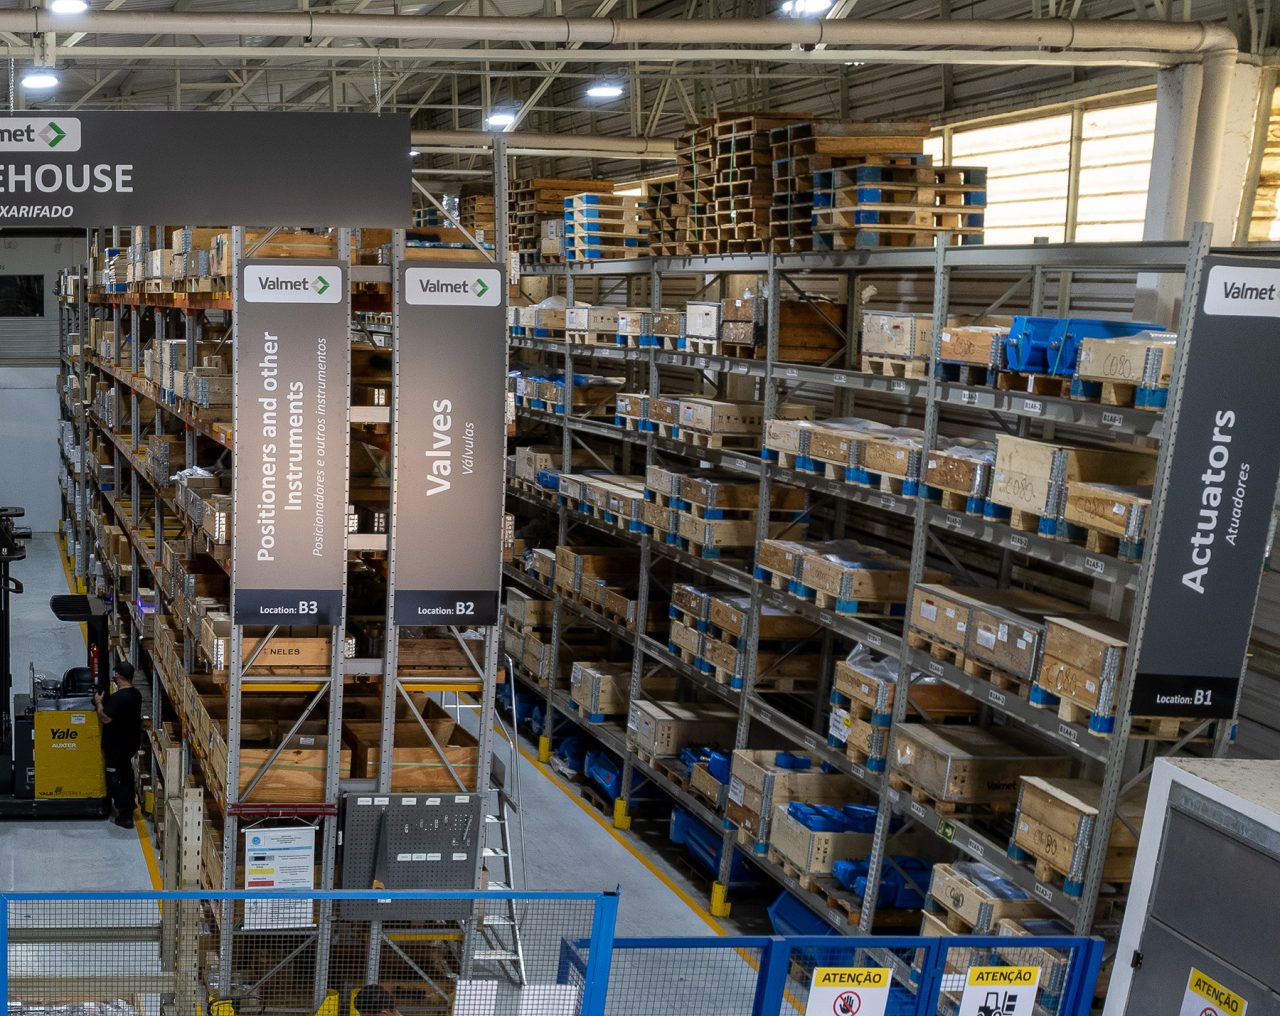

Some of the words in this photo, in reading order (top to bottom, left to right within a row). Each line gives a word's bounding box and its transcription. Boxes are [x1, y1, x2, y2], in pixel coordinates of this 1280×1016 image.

[258, 276, 309, 291] Valmet
[419, 279, 469, 294] Valmet
[1223, 281, 1276, 302] Valmet
[259, 332, 279, 391] other
[316, 337, 327, 417] instrumentos
[258, 396, 277, 437] and
[285, 380, 304, 511] Instruments
[316, 419, 326, 458] outros
[426, 399, 453, 496] Valves
[462, 421, 475, 475] Válvulas
[257, 443, 276, 561] Positioners
[313, 469, 325, 557] Posicionadores
[1181, 409, 1236, 595] Actuators
[1226, 462, 1250, 546] Atuadores
[260, 605, 298, 615] Location:
[298, 601, 318, 615] B3
[418, 606, 455, 616] Location:
[455, 602, 475, 615] B2
[1156, 694, 1193, 705] Location:
[1194, 689, 1213, 706] B1
[51, 729, 78, 740] Yale
[822, 971, 882, 985] ATENÇÃO
[976, 970, 1032, 983] ATENÇÃO
[1195, 978, 1238, 1013] ATENÇÃO
